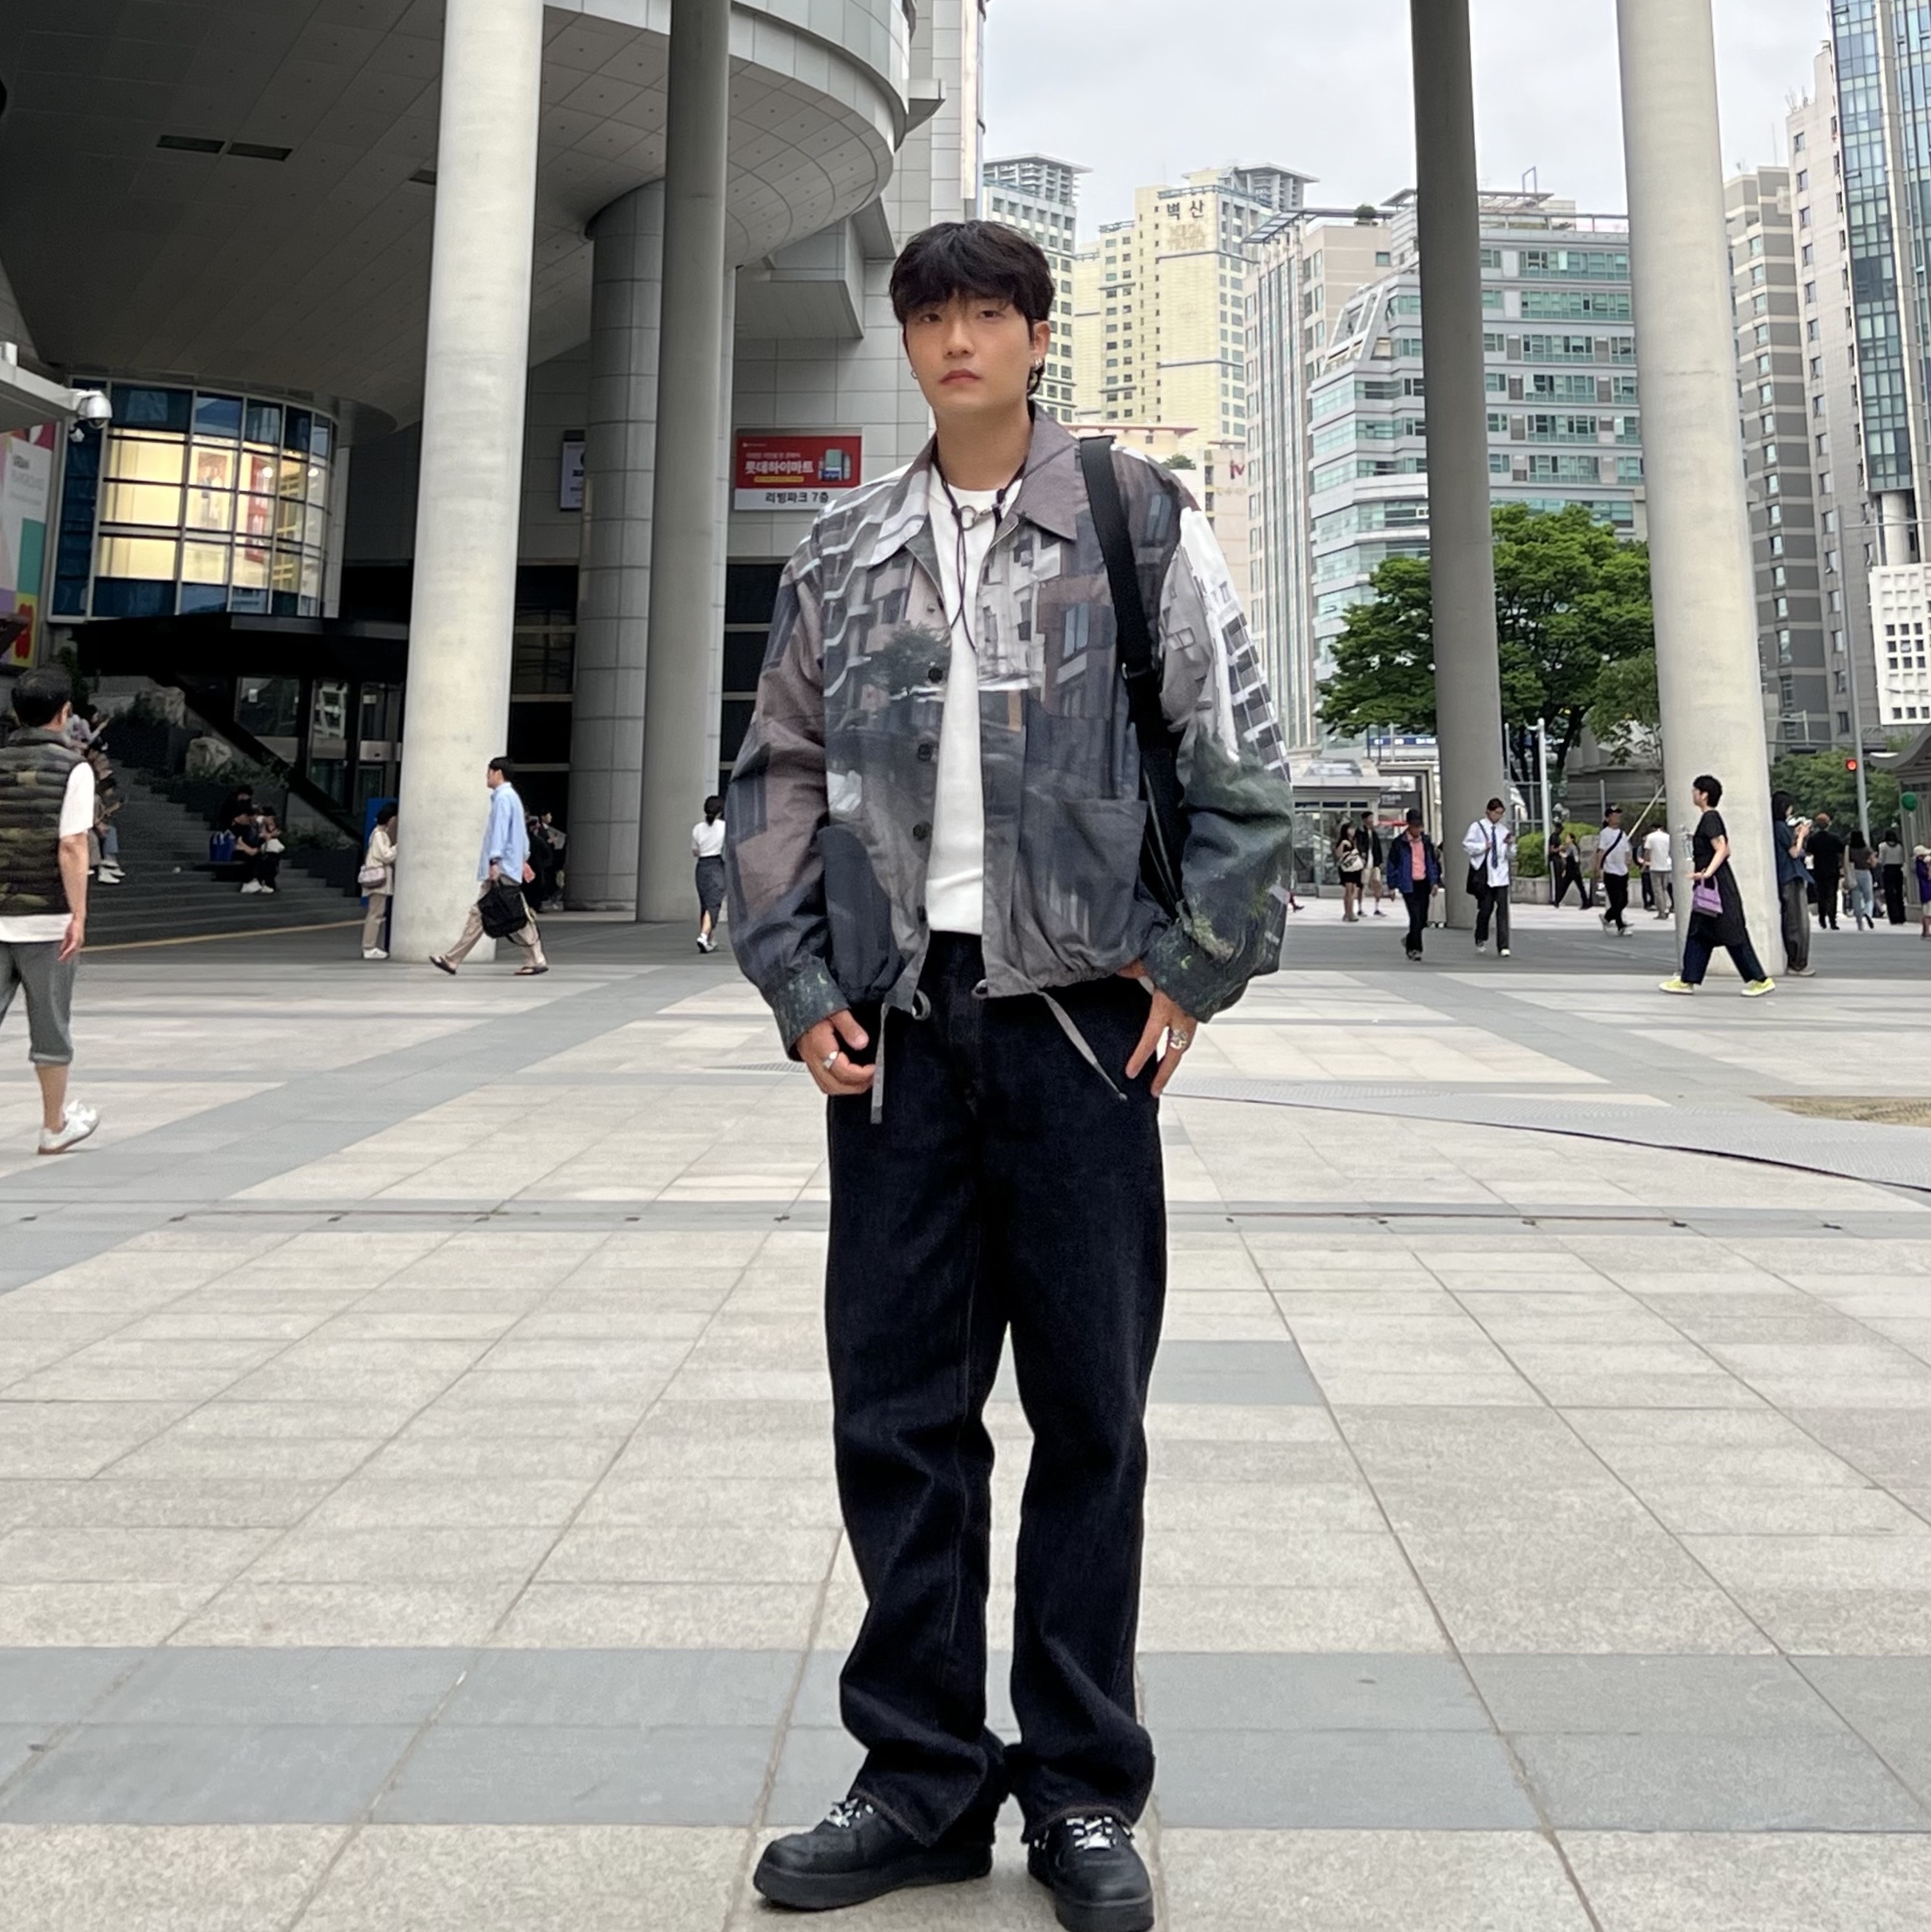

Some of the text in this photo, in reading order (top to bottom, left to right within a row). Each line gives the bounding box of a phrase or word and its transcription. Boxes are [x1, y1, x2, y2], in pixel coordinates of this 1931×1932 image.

[1167, 200, 1204, 220] 벽산
[745, 460, 814, 474] 롯데하이마트
[765, 492, 829, 504] 리빙파크 7층
